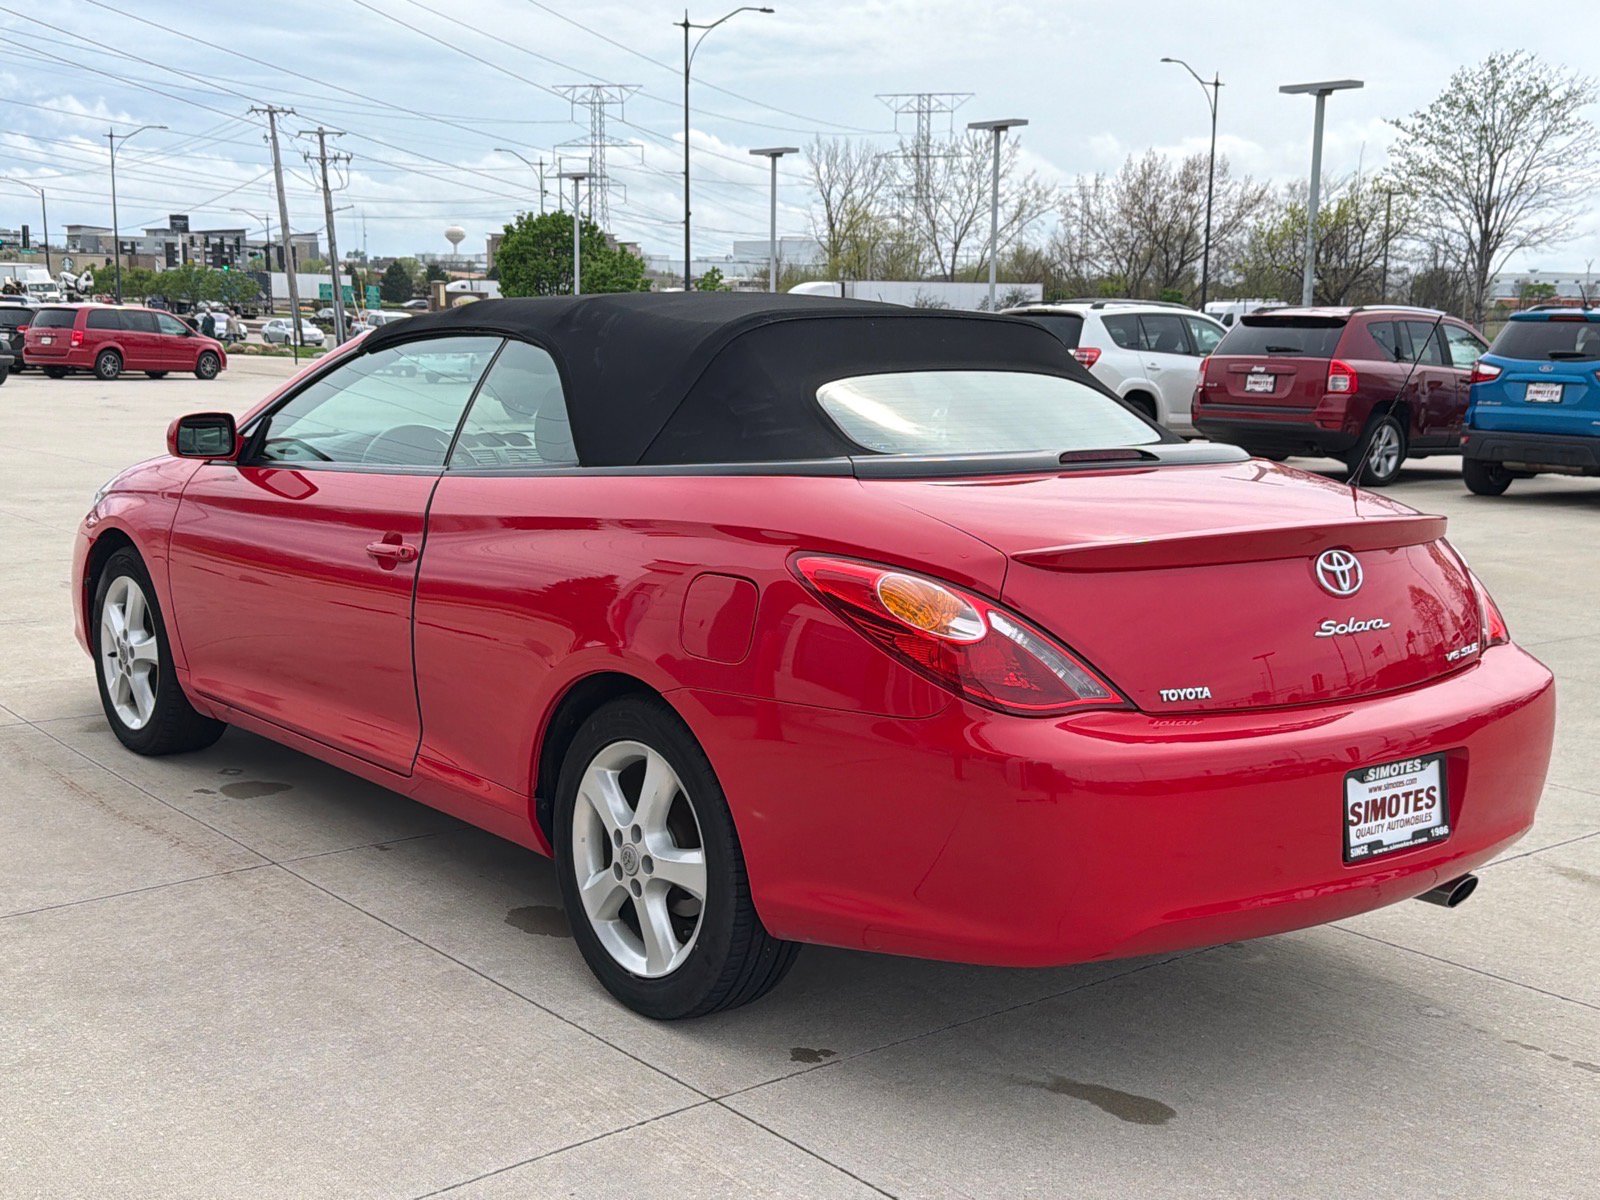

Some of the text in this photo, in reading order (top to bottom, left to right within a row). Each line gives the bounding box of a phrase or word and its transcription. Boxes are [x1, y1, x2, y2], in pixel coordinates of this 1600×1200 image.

[1314, 617, 1391, 637] Solara
[1445, 642, 1478, 661] V6 SLE
[1159, 686, 1212, 702] TOYOTA
[1367, 758, 1422, 781] SIMOTES
[1368, 777, 1418, 794] www.simotes.com
[1349, 785, 1437, 827] SIMOTES
[1355, 811, 1433, 839] QUALITY AUTOMOBILES
[1350, 844, 1369, 858] SINCE
